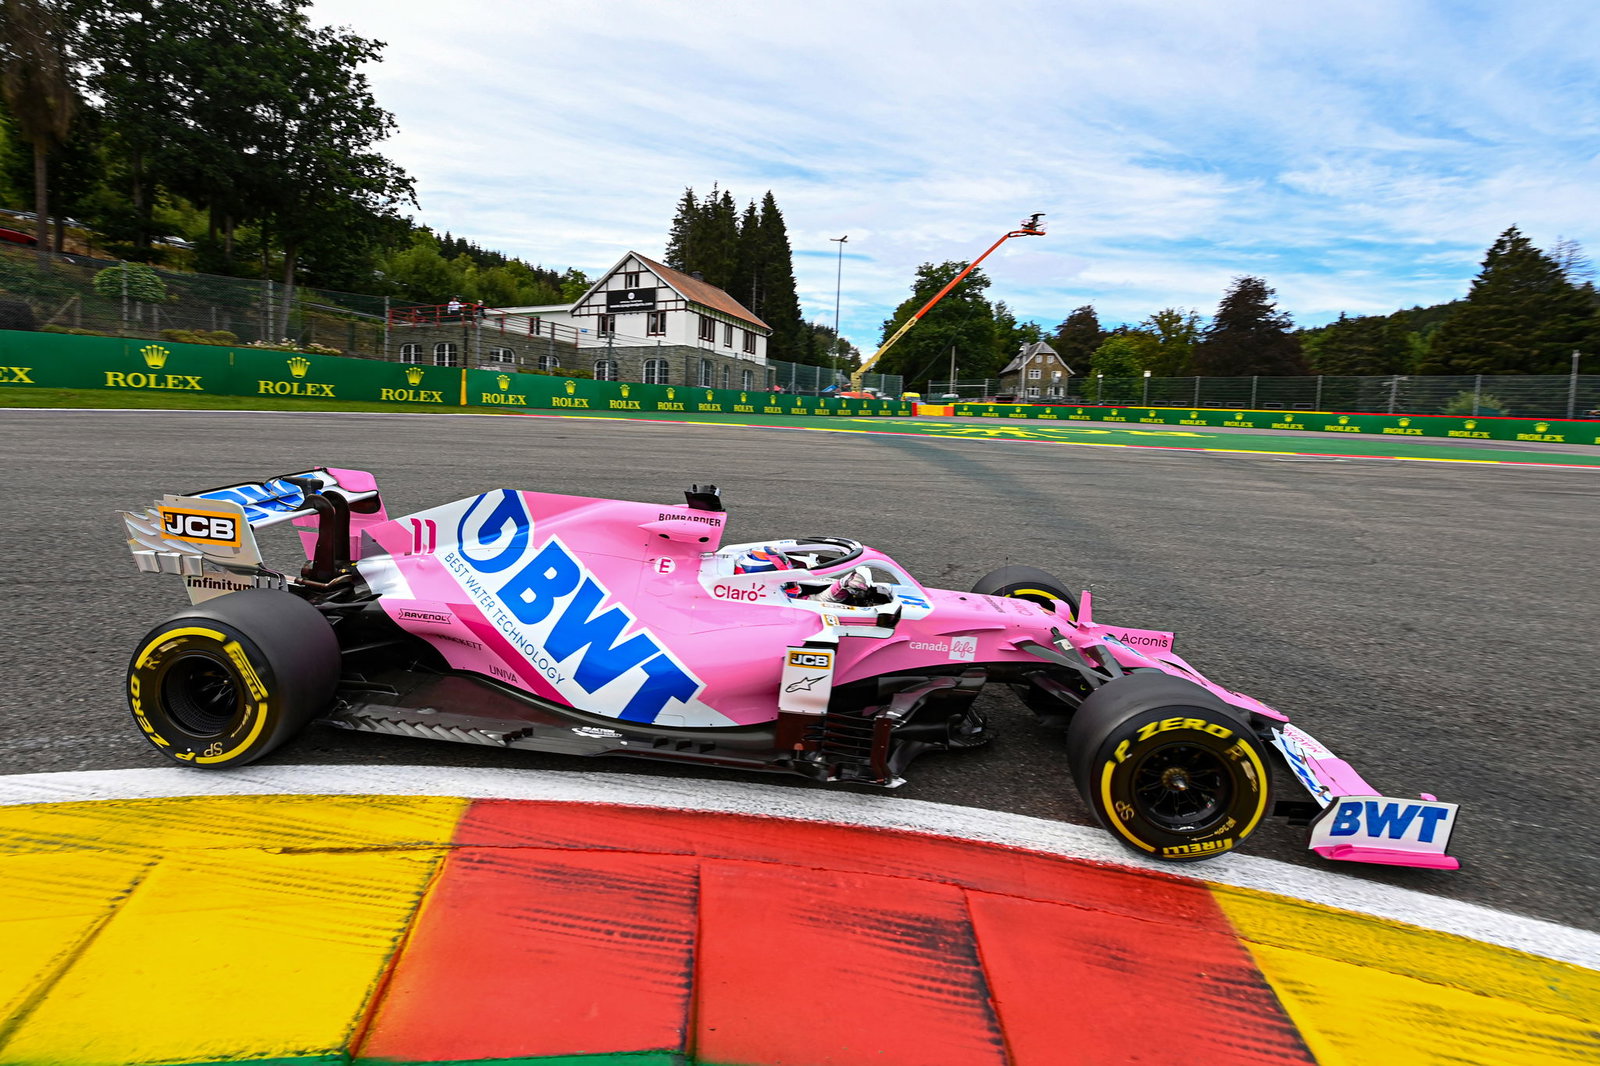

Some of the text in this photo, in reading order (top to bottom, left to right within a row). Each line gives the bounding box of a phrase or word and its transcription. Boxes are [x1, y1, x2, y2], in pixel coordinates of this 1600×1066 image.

[104, 371, 204, 390] ROLEX
[258, 380, 336, 397] ROLEX
[381, 388, 444, 403] ROLEX
[481, 392, 527, 405] ROLEX
[552, 396, 590, 408] ROLEX
[609, 399, 641, 410] ROLEX
[657, 401, 685, 411] ROLEX
[1324, 425, 1361, 433] ROLEX
[1383, 427, 1423, 436] ROLEX
[1448, 430, 1490, 439] ROLEX
[1516, 433, 1565, 443] ROLEX
[165, 514, 235, 539] JCB
[410, 518, 437, 554] 11
[659, 559, 671, 573] E
[187, 576, 255, 592] infinitum
[713, 583, 758, 601] Claro
[404, 611, 446, 622] RAVENOL
[444, 552, 566, 685] BEST WATER TECHNOLOGY
[495, 540, 701, 724] BWT
[1120, 633, 1168, 648] Acronis
[909, 640, 976, 658] canada life
[791, 654, 829, 667] JCB
[489, 665, 518, 684] UNIVA
[1137, 717, 1233, 742] ZERO
[1329, 801, 1449, 843] BWT
[1163, 838, 1233, 858] PIRELLI
